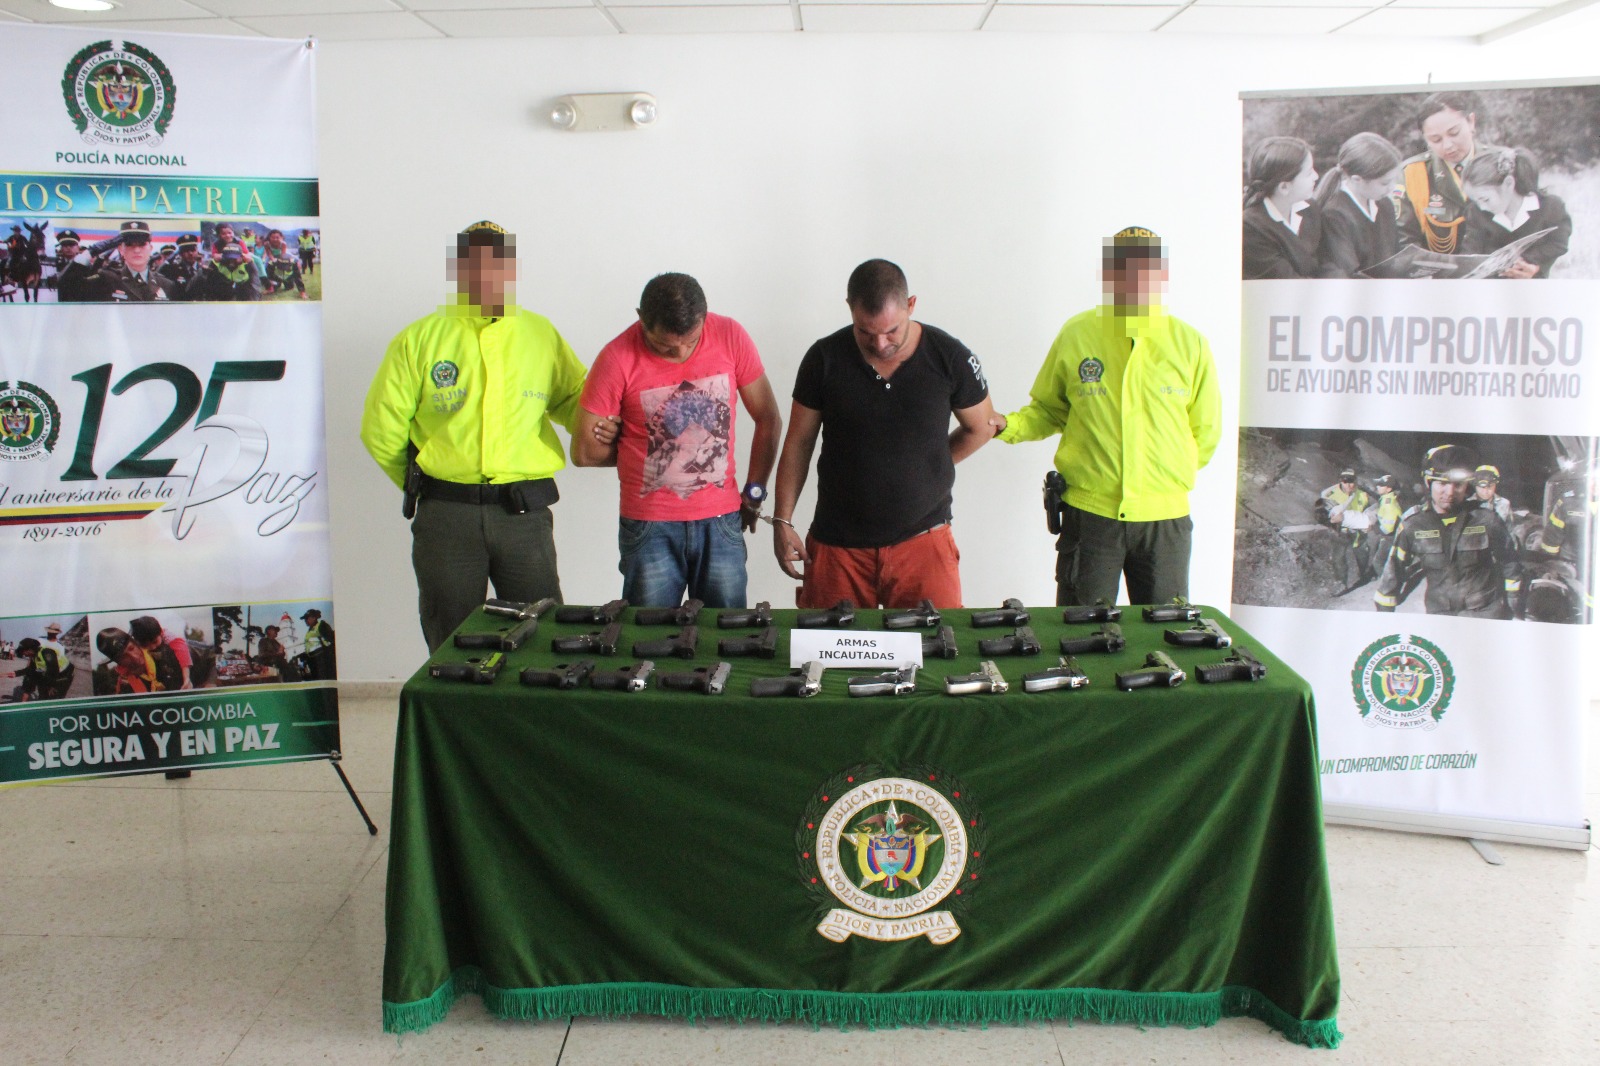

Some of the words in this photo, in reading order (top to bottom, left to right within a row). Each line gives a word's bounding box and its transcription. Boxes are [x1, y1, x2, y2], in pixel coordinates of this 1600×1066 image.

[135, 58, 162, 100] COLOMBIA
[122, 110, 159, 134] NACIONAL
[93, 130, 114, 143] DIOS
[122, 132, 151, 144] PATRIA
[55, 150, 110, 164] POLICÍA
[115, 153, 187, 167] NACIONAL
[88, 184, 112, 212] Y
[128, 185, 268, 216] PATRIA
[1268, 315, 1311, 362] EL
[1321, 314, 1583, 367] COMPROMISO
[1267, 368, 1291, 393] DE
[1295, 368, 1372, 394] AYUDAR
[1376, 369, 1408, 395] SIN
[1413, 370, 1516, 397] IMPORTAR
[1521, 368, 1581, 399] CÓMO
[27, 393, 50, 425] COLOMBIA
[60, 360, 286, 481] 125
[19, 450, 41, 460] PATRIA
[155, 480, 173, 498] la
[162, 414, 318, 540] Paz
[12, 486, 122, 505] aniversario
[128, 481, 151, 499] de
[23, 522, 107, 542] 1891-2016
[836, 638, 877, 648] ARMAS
[819, 650, 895, 661] INCAUTADAS
[1419, 650, 1442, 689] COLOMBIA
[49, 716, 91, 733] POR
[97, 711, 144, 731] UNA
[149, 702, 256, 726] COLOMBIA
[1400, 695, 1439, 717] NACIONAL
[1374, 714, 1392, 726] DIOS
[1400, 717, 1427, 727] PATRIA
[27, 733, 145, 770] SEGURA
[151, 731, 172, 758] Y
[180, 726, 216, 757] EN
[225, 722, 280, 753] PAZ
[1320, 759, 1335, 774] UN
[1336, 755, 1409, 774] COMPROMISO
[1410, 755, 1425, 771] DE
[1425, 750, 1477, 769] CORAZÓN
[822, 790, 872, 860] REPUBLICA
[881, 784, 904, 795] DE
[915, 790, 961, 856] COLOMBIA
[829, 872, 878, 911] POLICIA
[893, 869, 956, 912] NACIONAL
[834, 913, 870, 932] DIOS
[875, 923, 885, 936] Y
[891, 914, 946, 935] PATRIA
